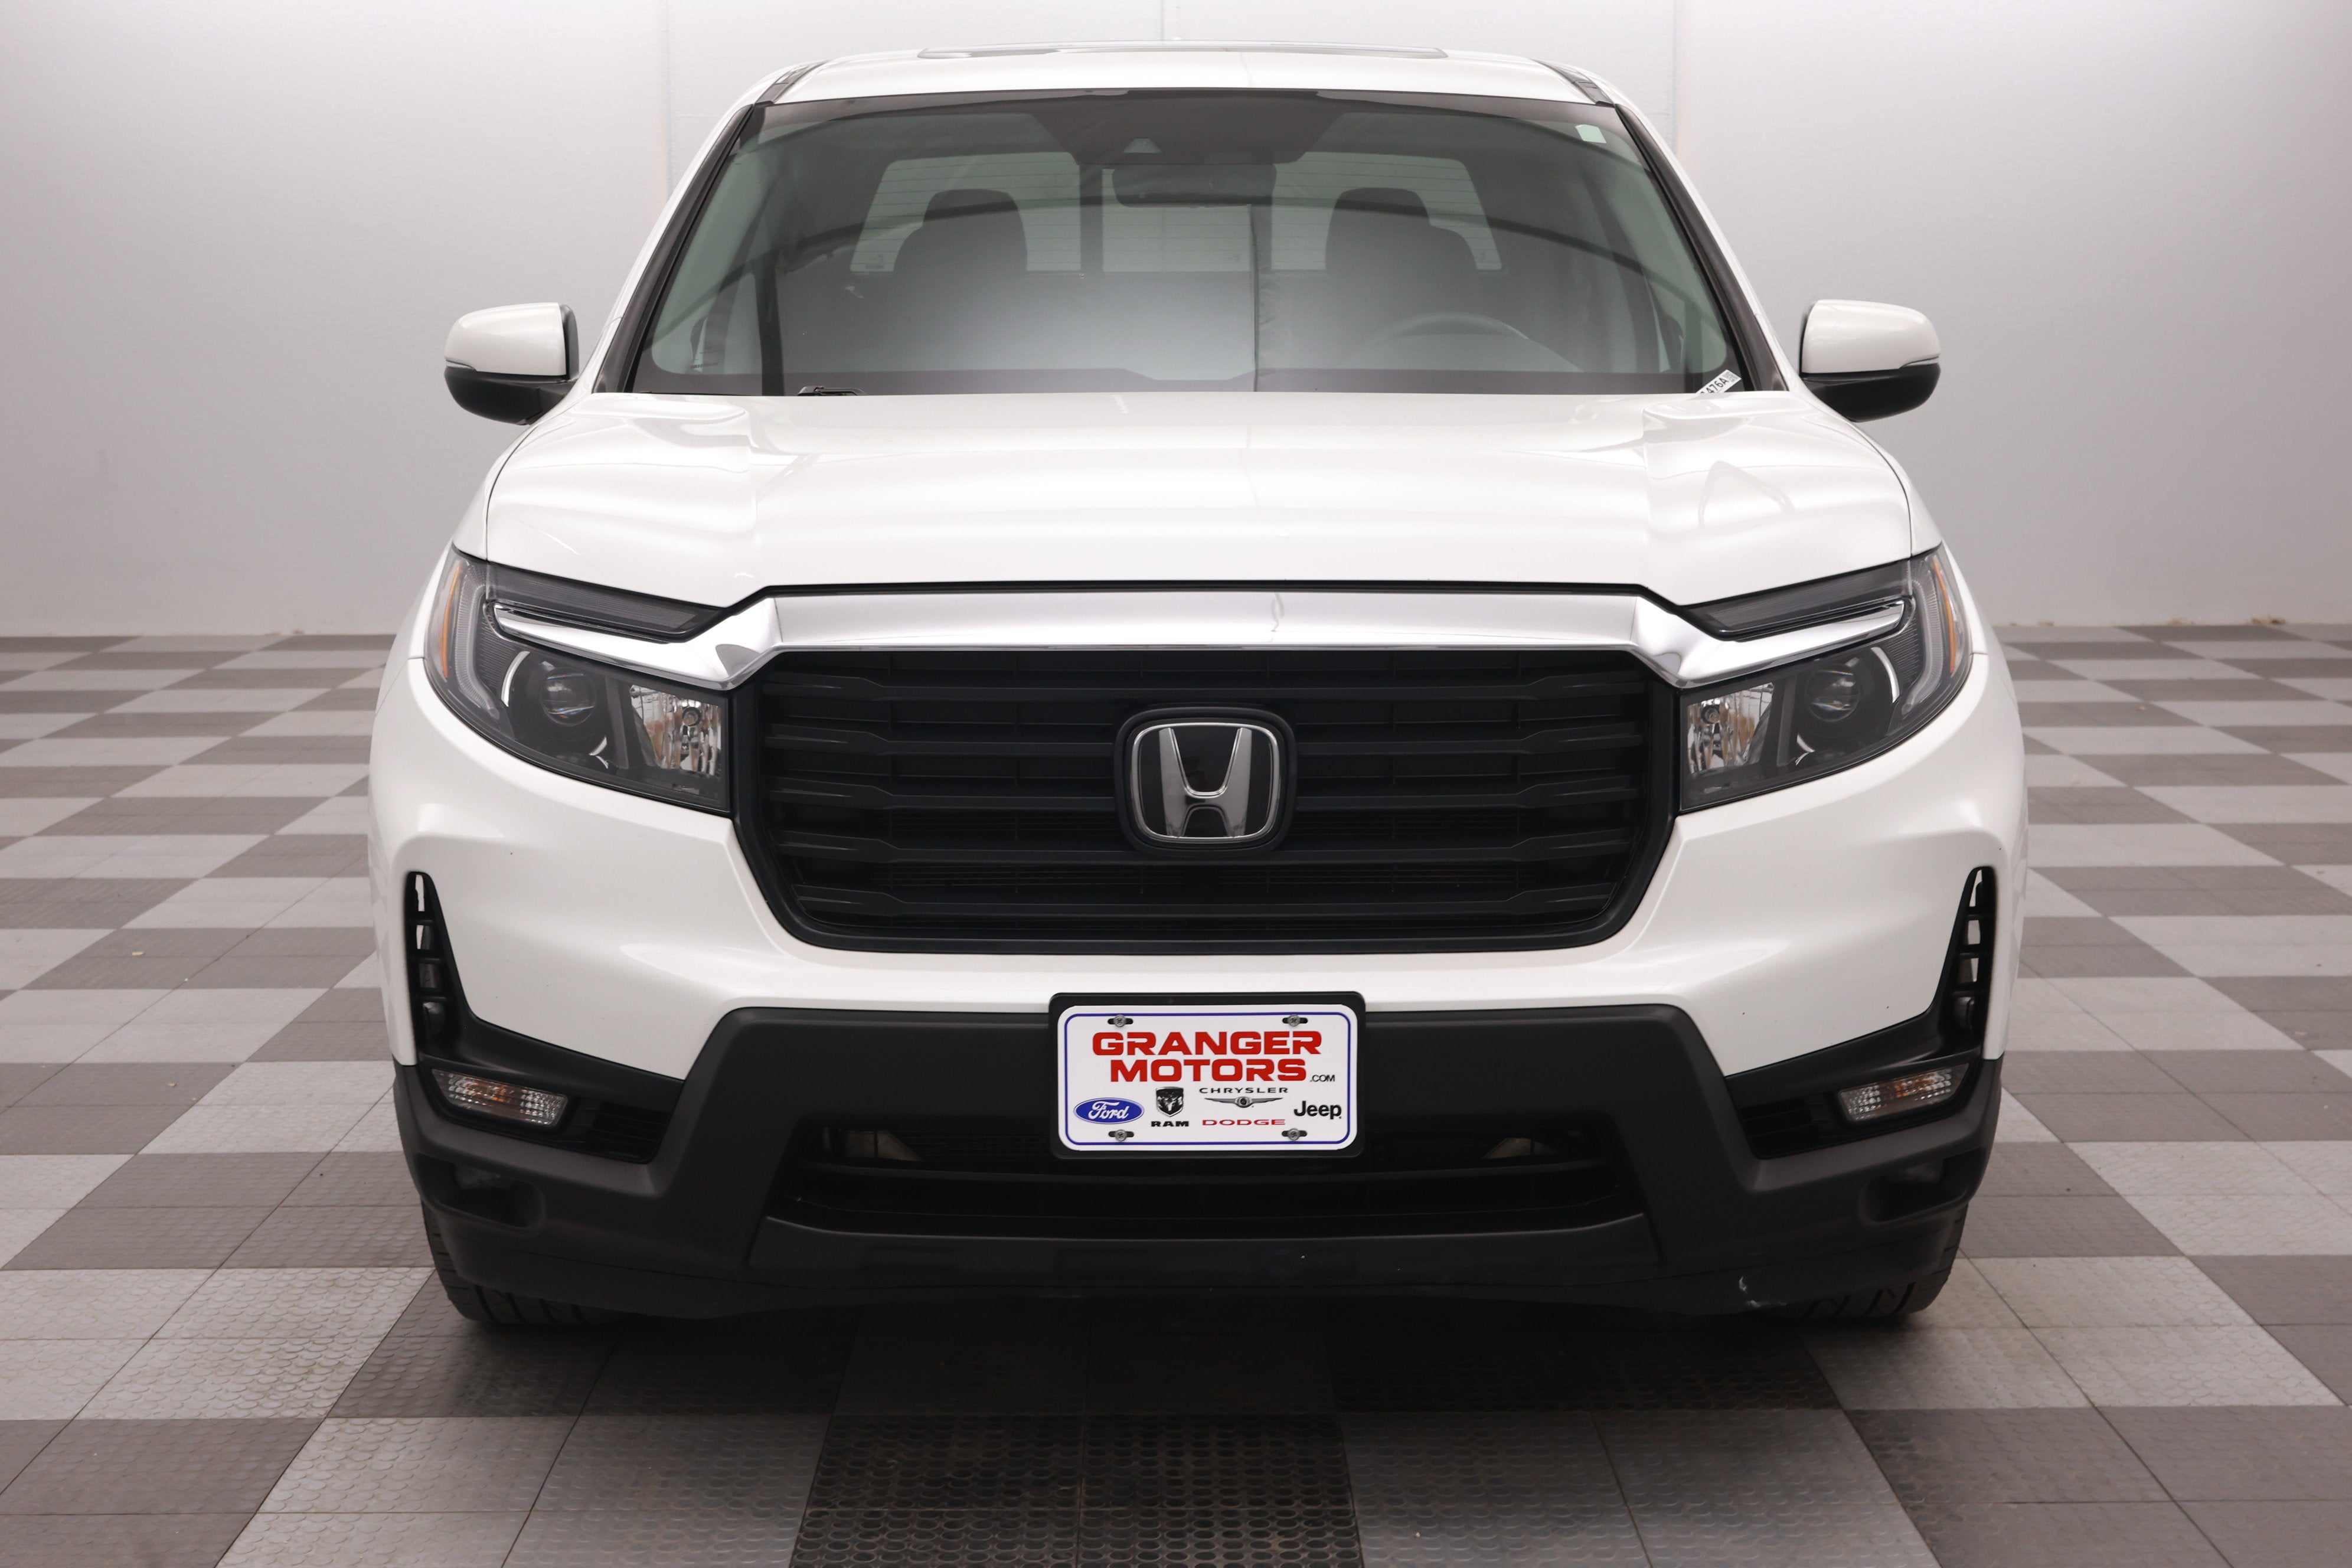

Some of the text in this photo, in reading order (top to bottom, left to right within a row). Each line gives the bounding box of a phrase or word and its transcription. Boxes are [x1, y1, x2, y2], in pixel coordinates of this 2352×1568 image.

[1700, 377, 1729, 394] 476A
[1092, 1030, 1322, 1056] GRANGER
[1110, 1059, 1336, 1083] MOTORS .COM
[1088, 1100, 1129, 1120] Ford
[1293, 1100, 1342, 1120] Jeep
